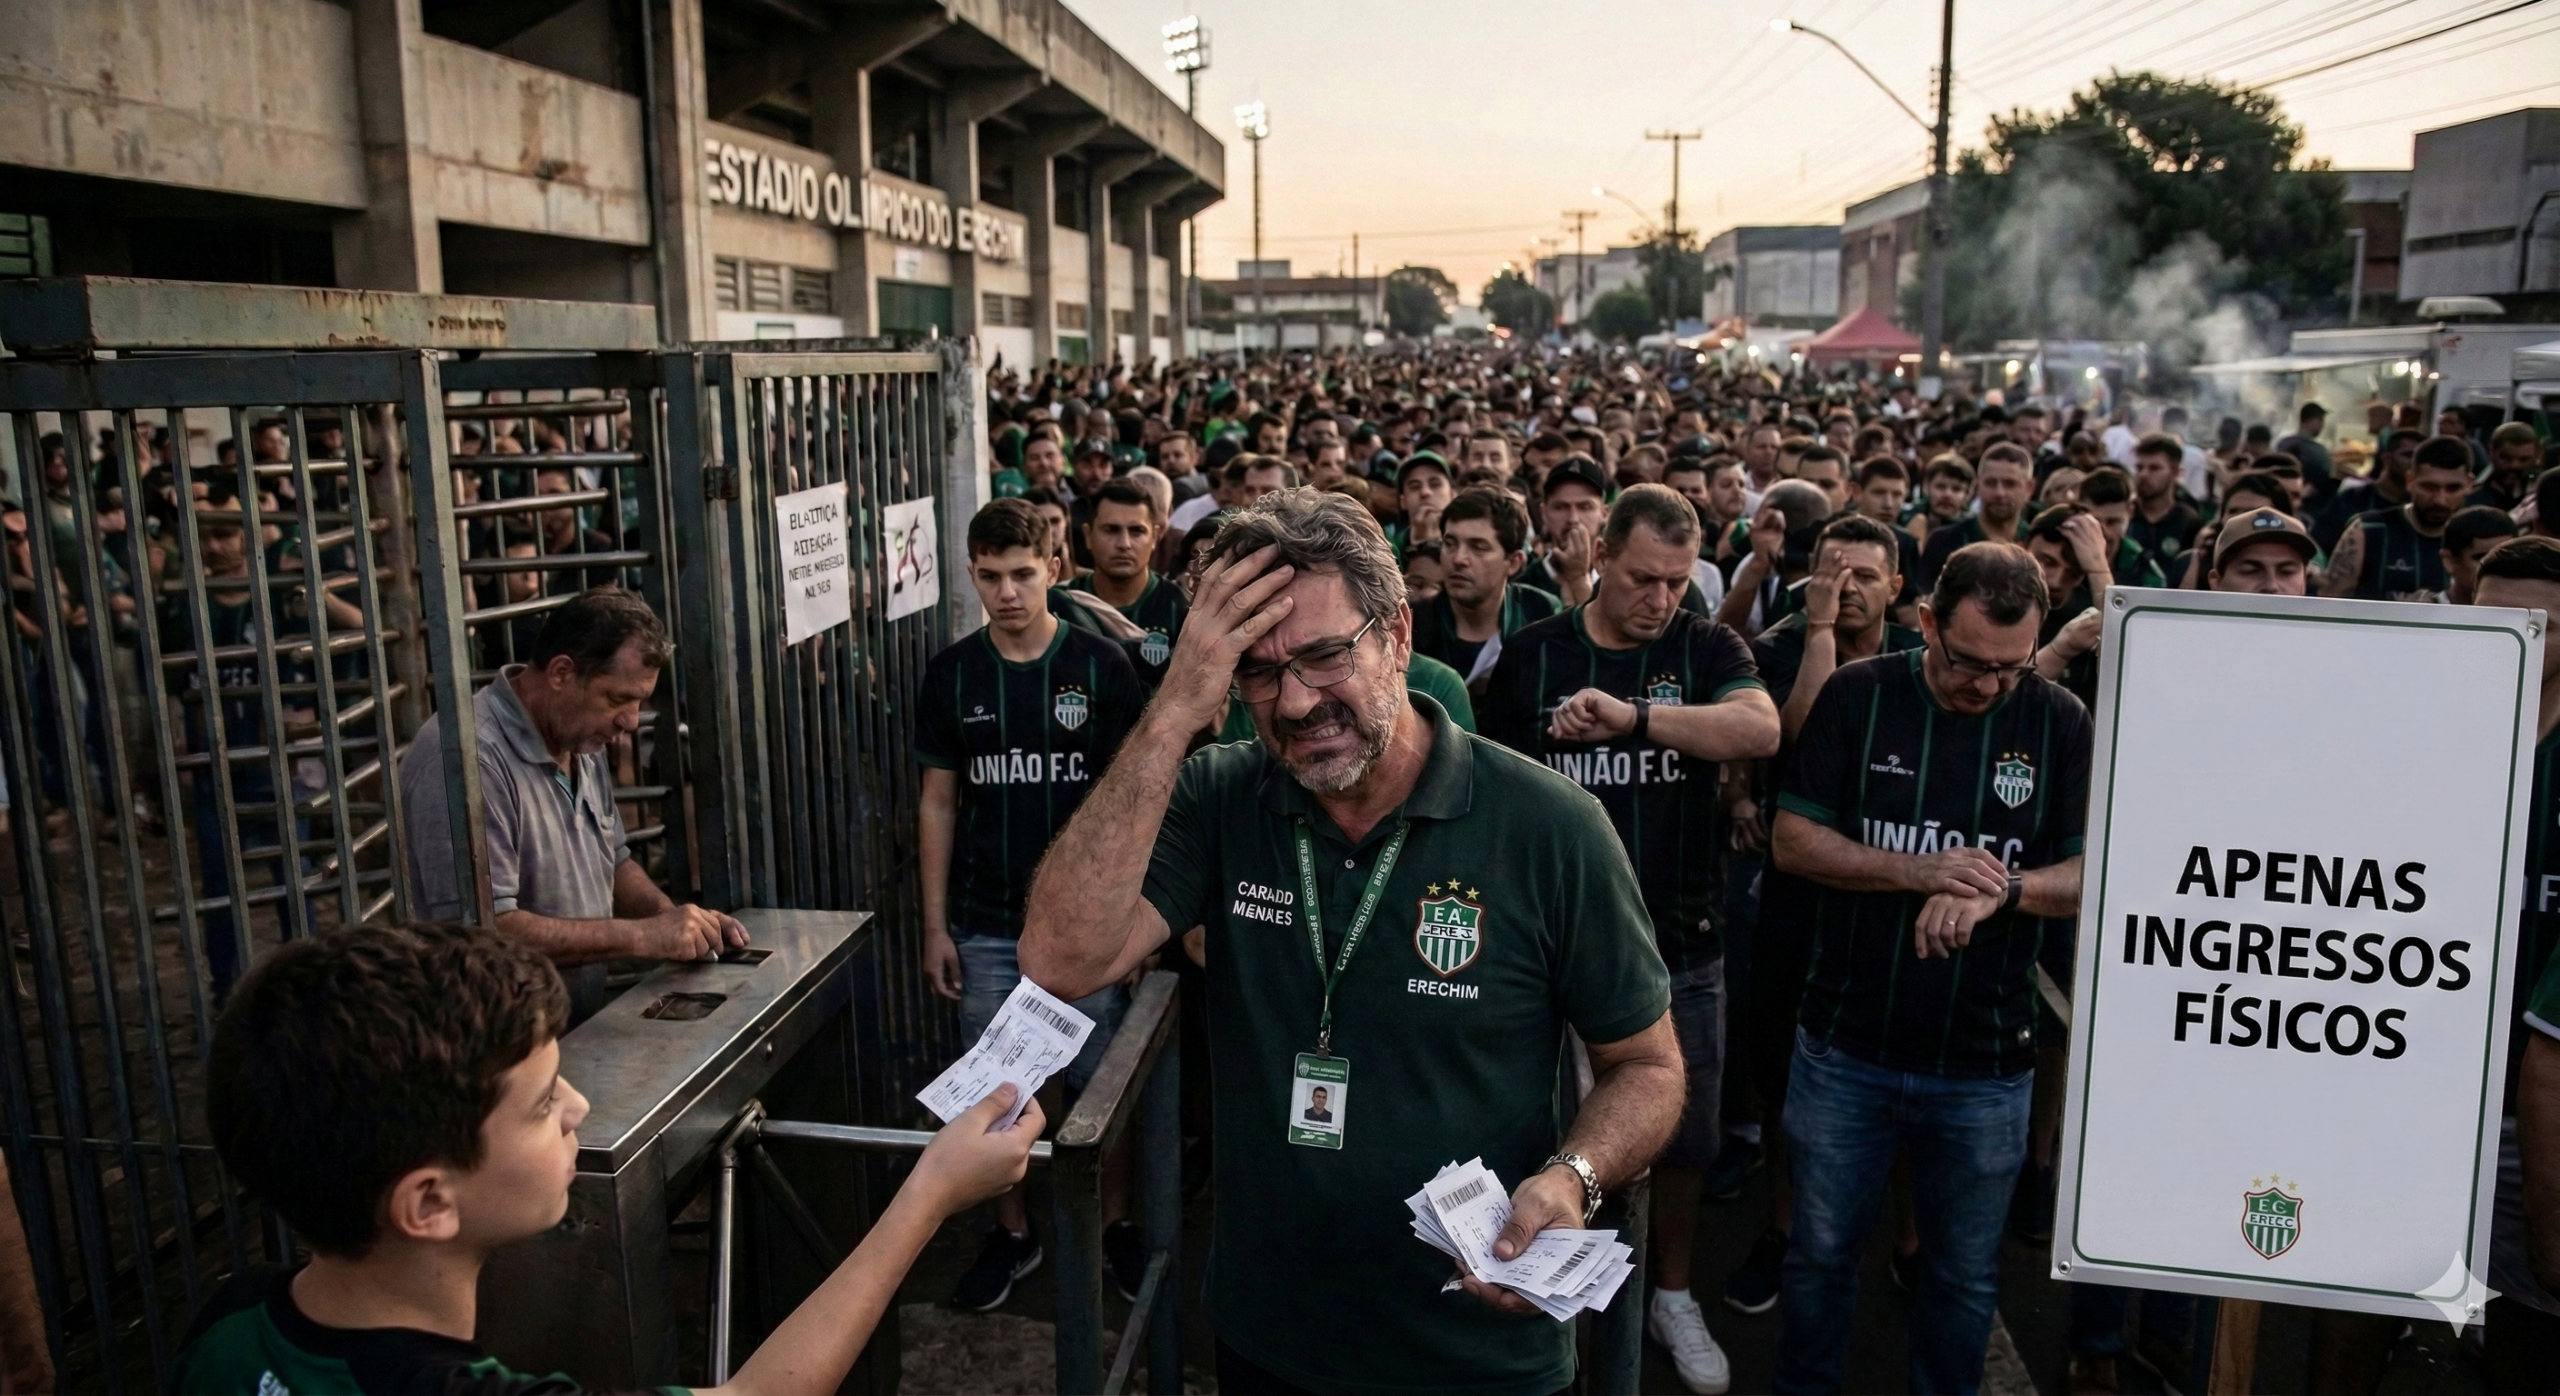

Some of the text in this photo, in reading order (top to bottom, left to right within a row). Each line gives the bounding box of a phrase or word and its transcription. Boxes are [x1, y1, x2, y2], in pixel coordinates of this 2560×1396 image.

[926, 199, 952, 248] DO
[970, 748, 1089, 784] UNIÃO F.C.
[1639, 749, 1686, 784] F.C.
[2176, 846, 2427, 913] APENAS
[2123, 914, 2472, 991] INGRESSOS
[1407, 978, 1479, 999] ERECHIM
[2173, 983, 2407, 1060] FÍSICOS
